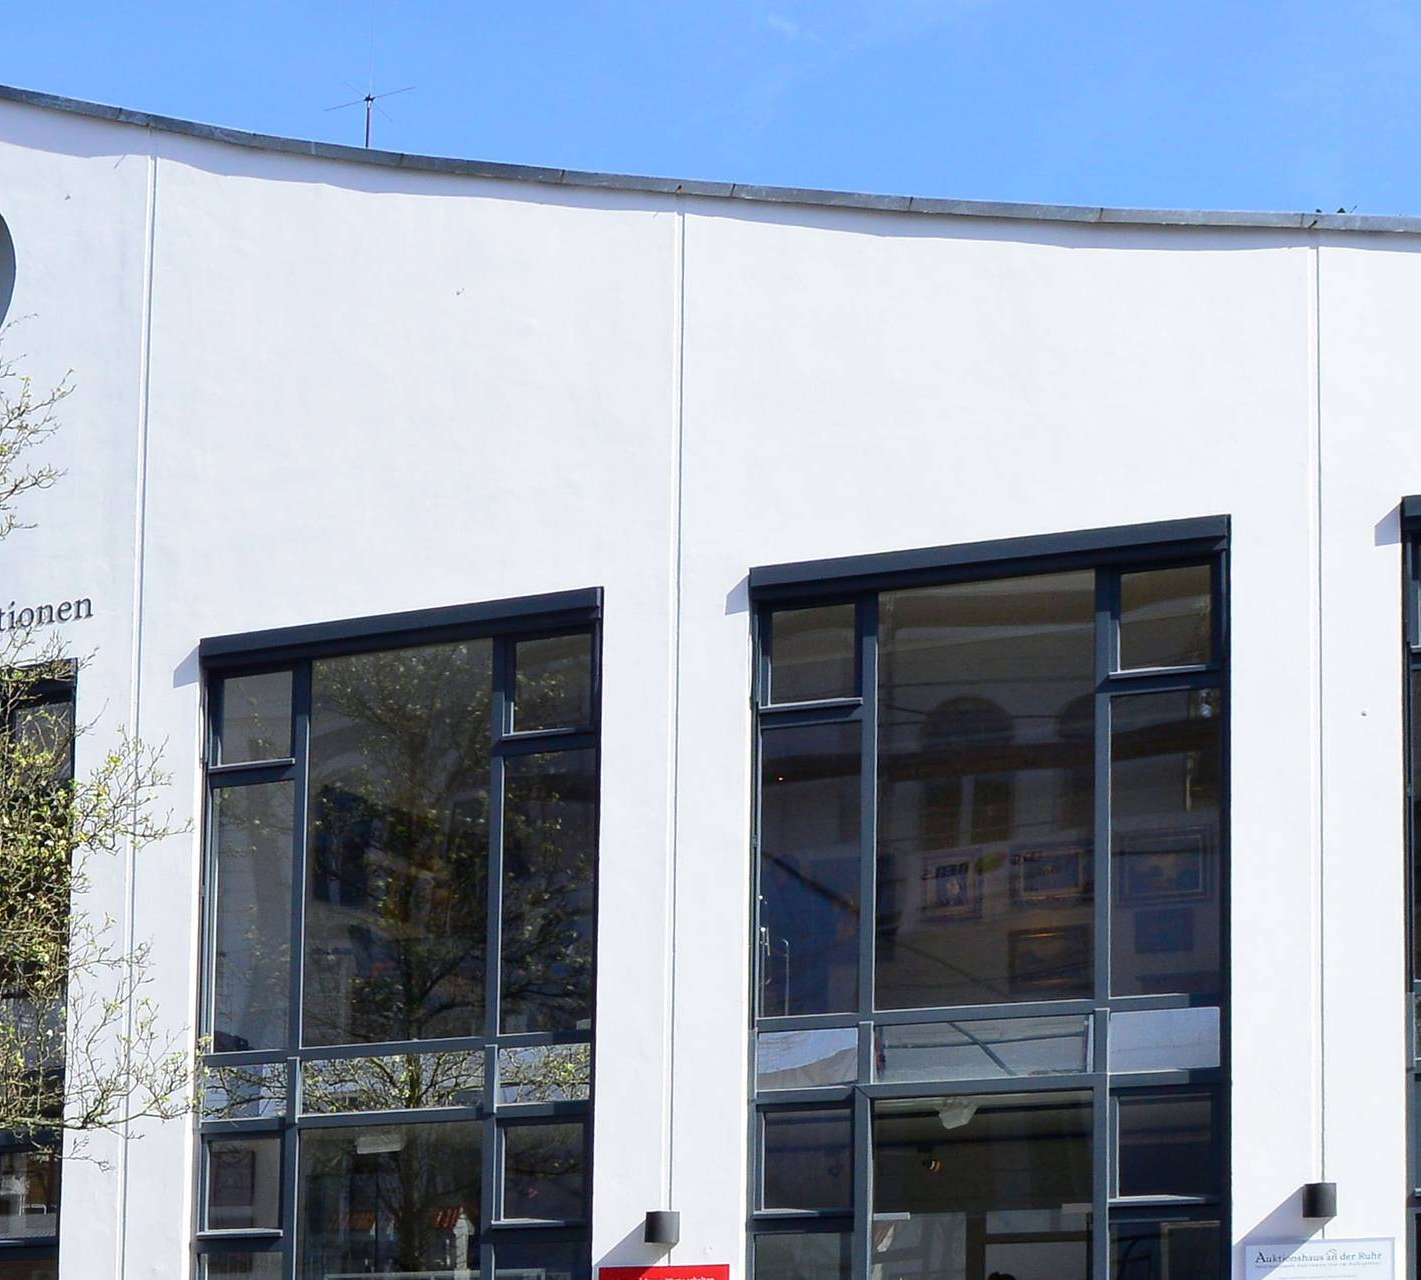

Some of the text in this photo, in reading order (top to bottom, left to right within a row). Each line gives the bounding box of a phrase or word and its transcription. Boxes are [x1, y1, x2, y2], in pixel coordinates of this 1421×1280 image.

[1255, 1251, 1324, 1264] Auktionshaus
[1340, 1252, 1356, 1261] der
[1358, 1251, 1382, 1260] Ruhr
